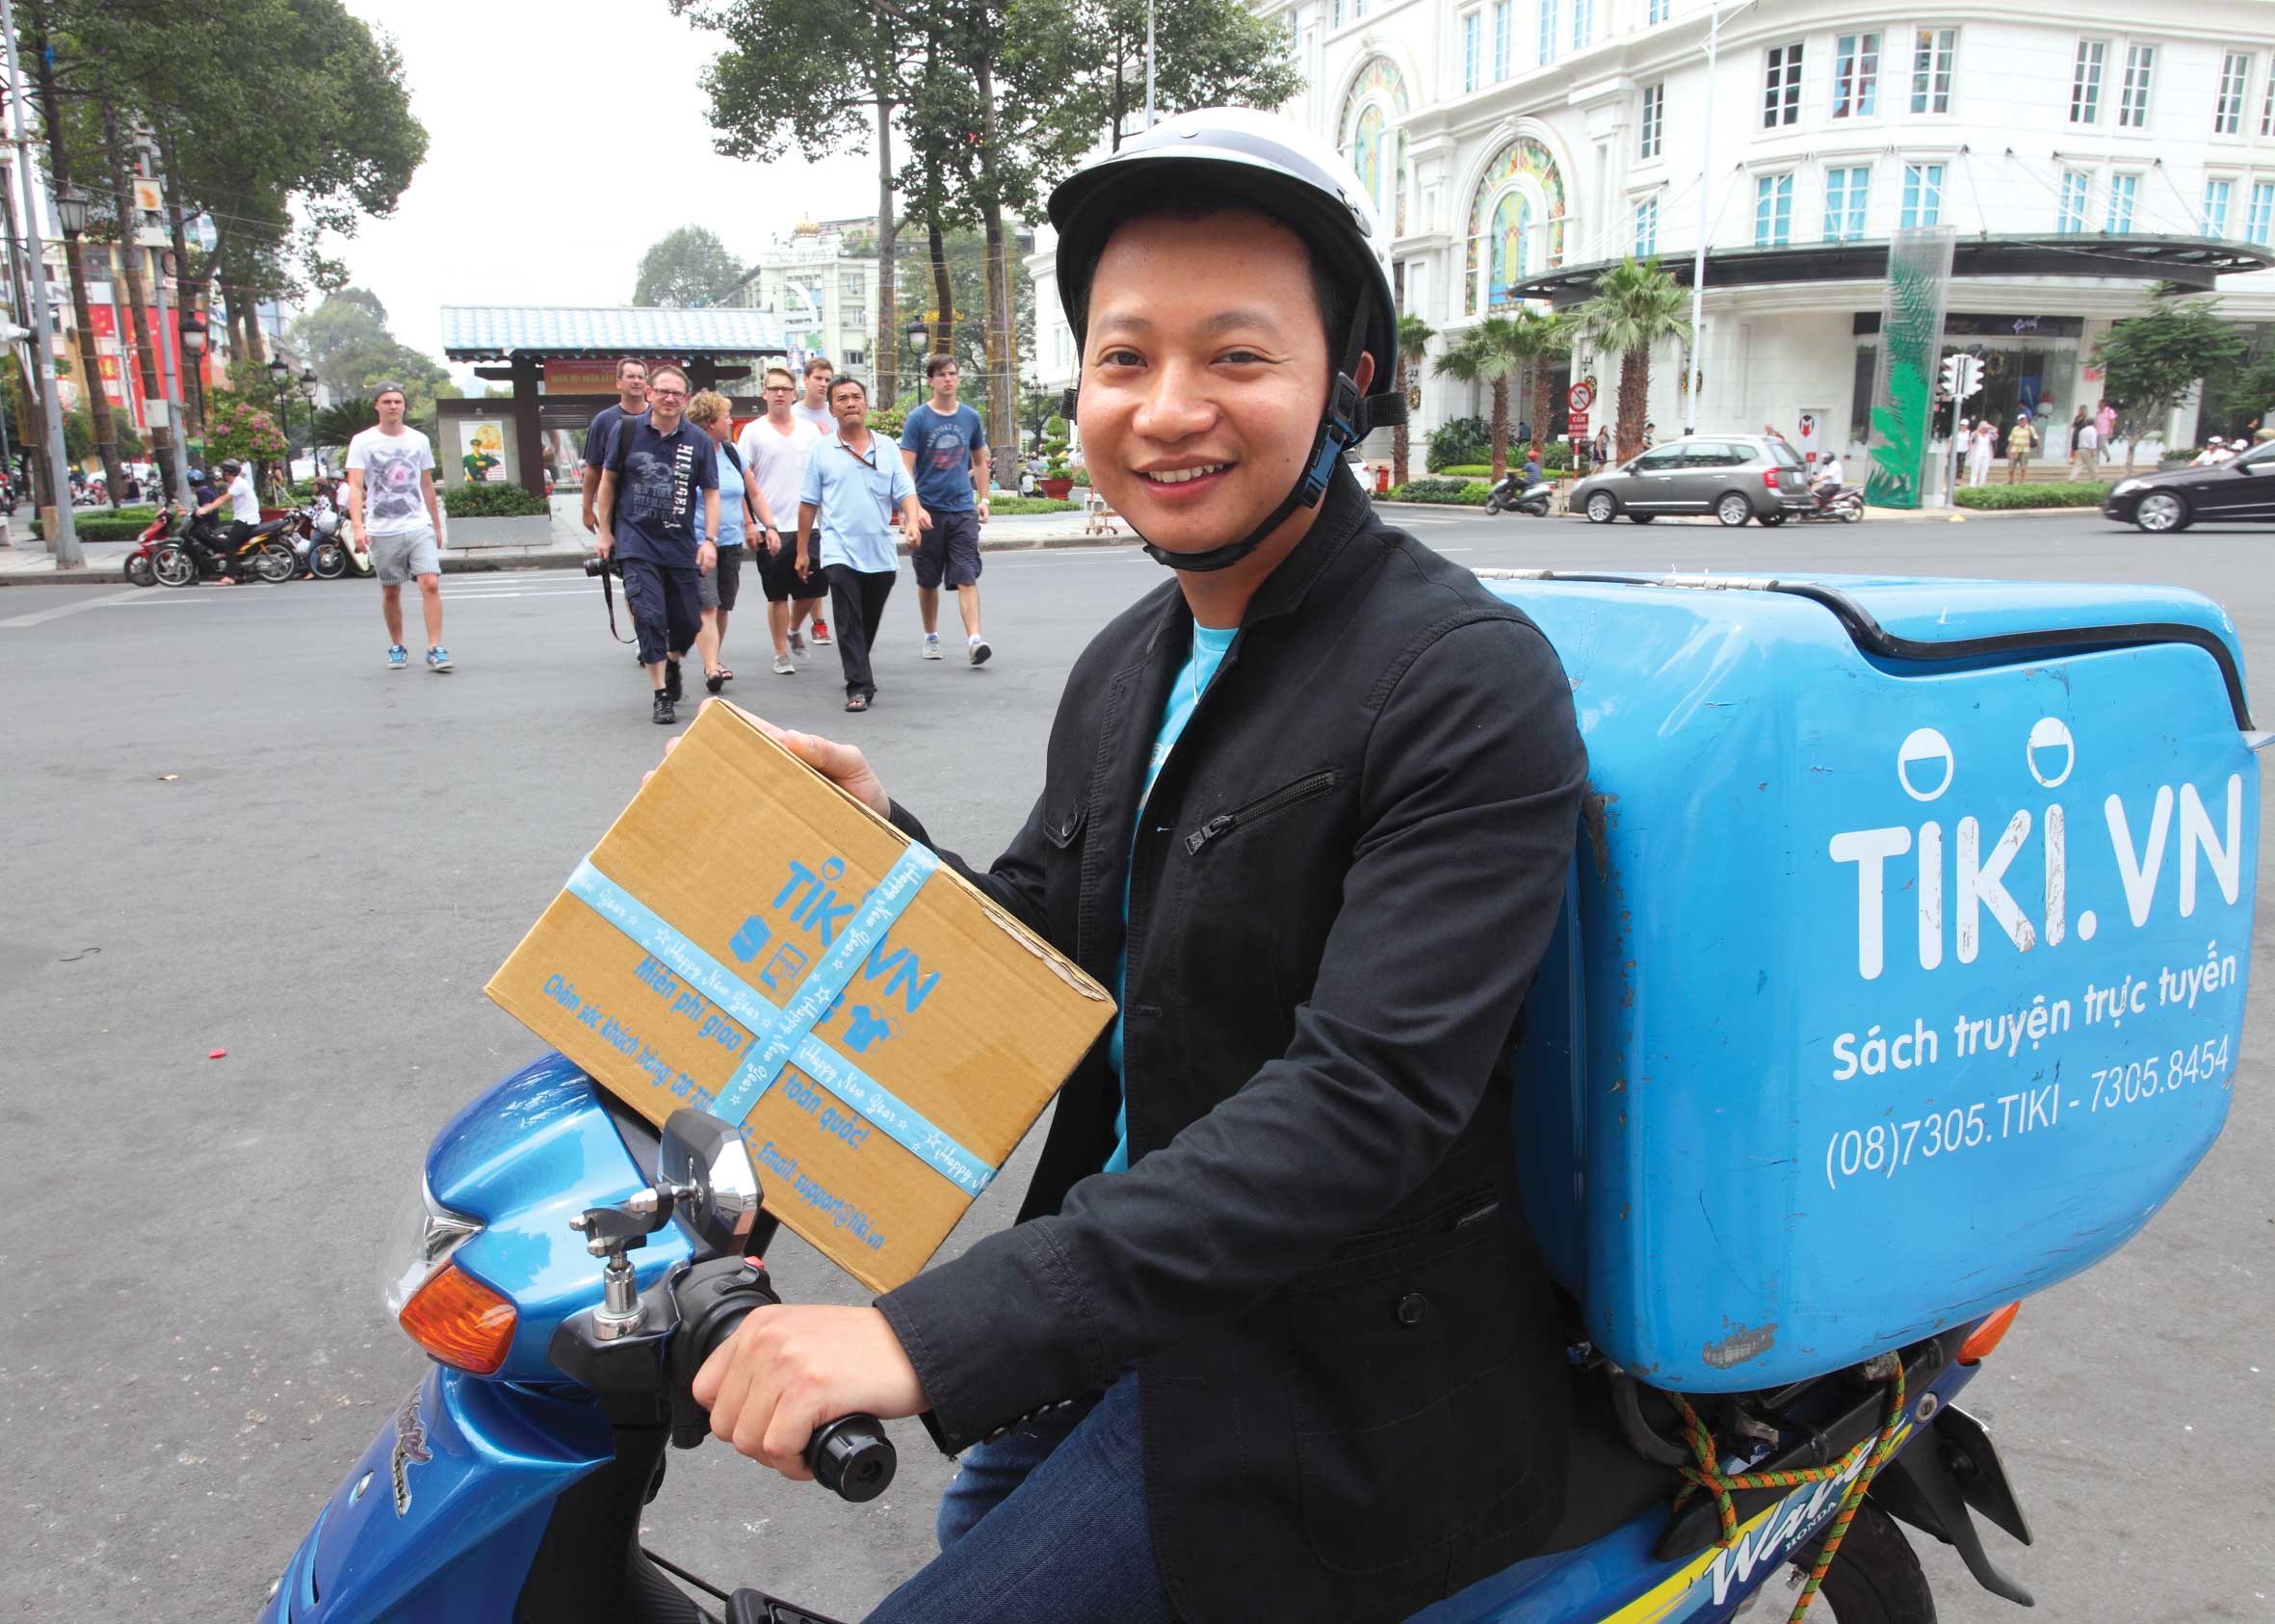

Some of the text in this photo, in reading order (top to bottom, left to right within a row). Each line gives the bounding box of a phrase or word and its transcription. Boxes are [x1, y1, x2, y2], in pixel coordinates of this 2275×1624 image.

[671, 443, 693, 514] HILFIGER
[841, 861, 922, 958] Happy New Year
[663, 939, 760, 1020] Happy New Year
[1833, 939, 2236, 1081] Sách truyện trực tuyến
[669, 987, 712, 1023] phí
[697, 1013, 743, 1053] giao
[764, 1034, 790, 1061] New
[779, 996, 817, 1035] Happy
[578, 1004, 604, 1031] sóc
[599, 1016, 641, 1057] khách
[670, 1072, 695, 1100] 08
[738, 1062, 768, 1092] Year
[799, 1038, 839, 1083] Happy
[837, 1071, 865, 1099] New
[867, 1093, 897, 1123] Year
[2091, 1033, 2229, 1113] 7305.8454
[781, 1072, 823, 1115] toàn
[934, 1143, 974, 1183] Happy
[792, 1172, 886, 1252] support@tiki.vn
[1786, 1501, 1838, 1552] HONDA
